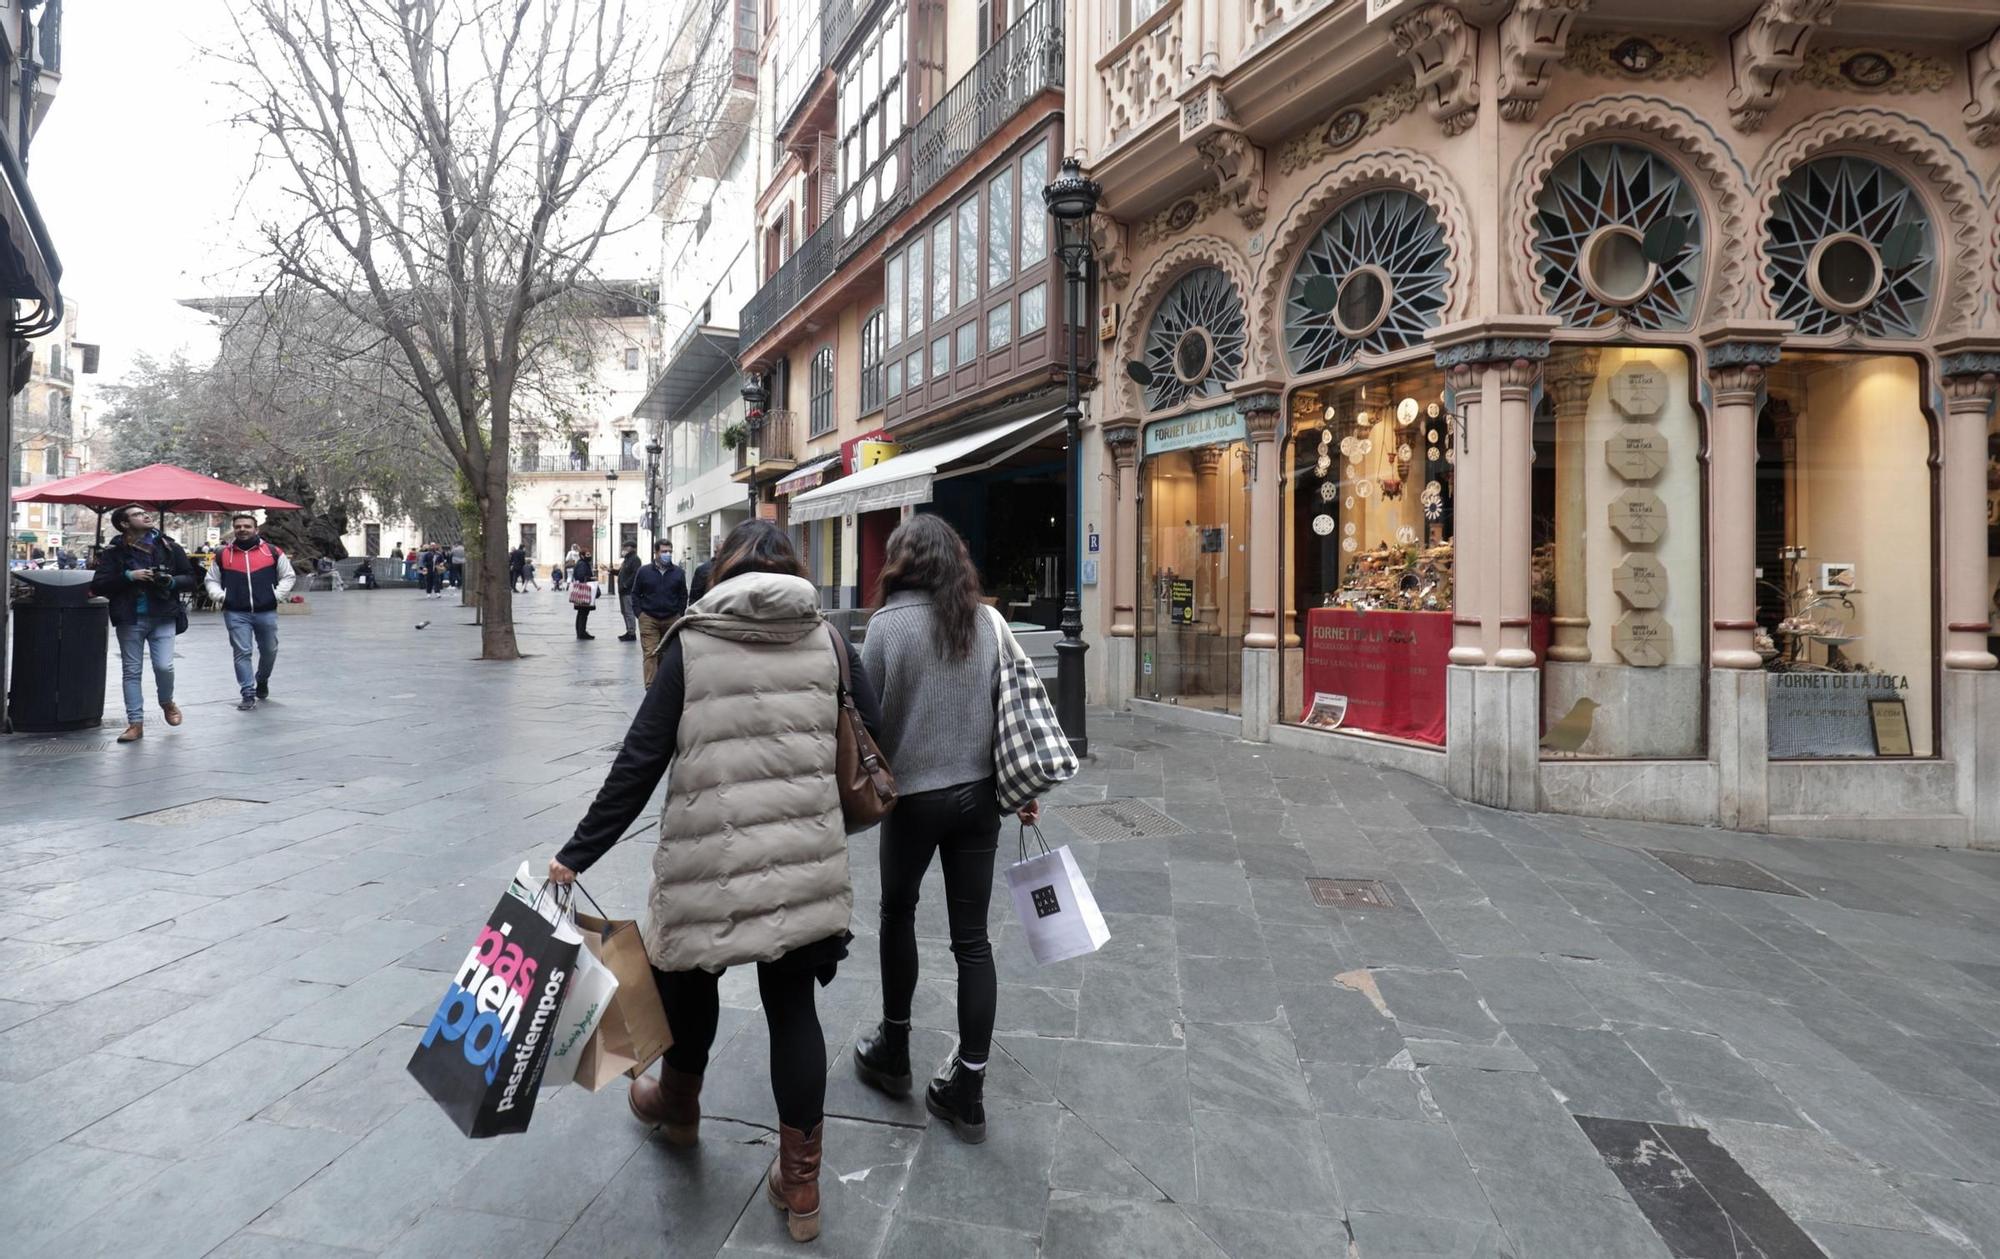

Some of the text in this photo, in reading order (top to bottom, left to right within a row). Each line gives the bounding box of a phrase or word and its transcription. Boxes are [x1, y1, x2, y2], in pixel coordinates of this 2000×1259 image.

[1155, 425, 1184, 441] FORNET
[1187, 422, 1198, 434] DE
[1200, 418, 1211, 432] LA
[1090, 535, 1098, 548] R
[1312, 626, 1350, 641] FORNET
[1369, 629, 1383, 642] LA
[1776, 674, 1828, 689] FORNET
[1832, 674, 1849, 689] DE
[1852, 675, 1871, 689] LA
[496, 966, 565, 1113] pasatiempos
